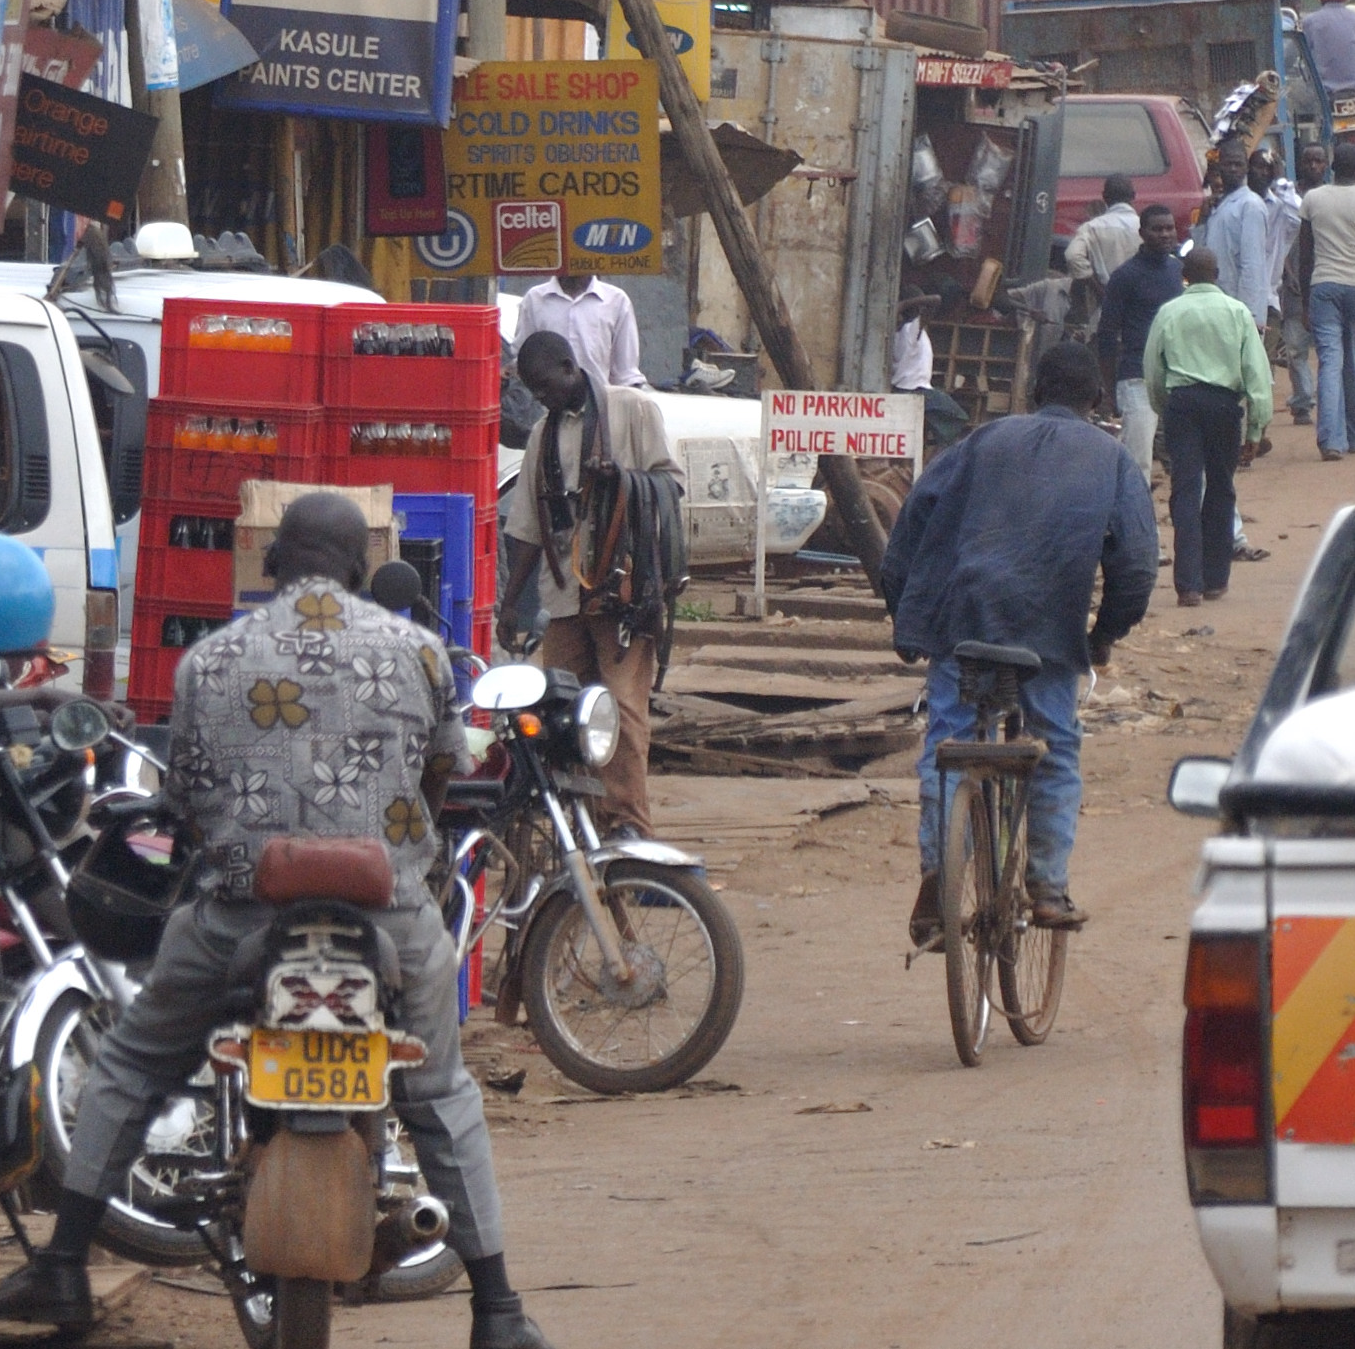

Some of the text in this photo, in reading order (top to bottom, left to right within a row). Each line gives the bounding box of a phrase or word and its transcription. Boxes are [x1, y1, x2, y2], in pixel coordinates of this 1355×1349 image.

[280, 28, 381, 60] KASULE
[327, 68, 422, 98] CENTER
[497, 72, 559, 102] SALE
[568, 71, 640, 100] SHOP
[458, 110, 641, 137] COLD DRINKS
[448, 172, 527, 200] RTIME
[539, 171, 641, 197] CARDS
[500, 206, 558, 230] celtel
[585, 224, 638, 247] MTN
[570, 255, 652, 270] PUBLIC PHONE
[772, 393, 886, 418] NO PARKING
[771, 429, 906, 455] POLICE NOTICE
[302, 1031, 371, 1064] UDG
[283, 1067, 372, 1100] 058A
